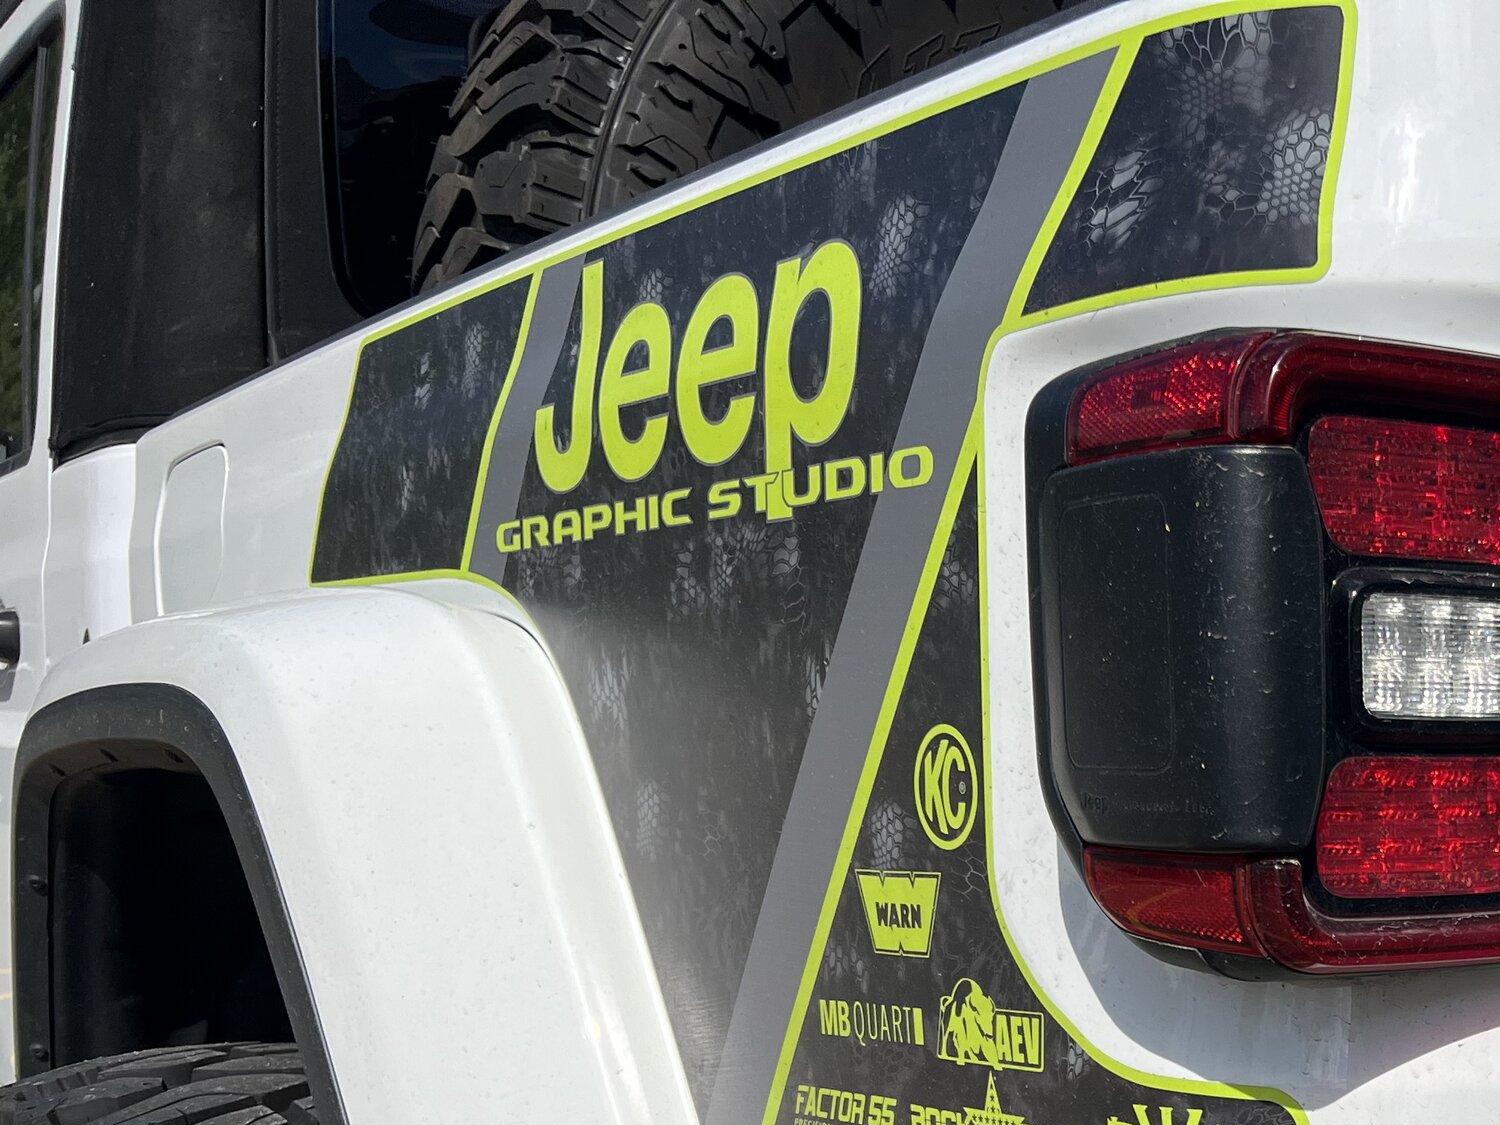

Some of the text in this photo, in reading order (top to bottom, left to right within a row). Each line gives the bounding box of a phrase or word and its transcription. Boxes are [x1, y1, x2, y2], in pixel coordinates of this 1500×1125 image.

[534, 239, 861, 521] Jeep
[496, 445, 934, 553] GRAPHIC STUDIO
[876, 900, 922, 930] WARN
[996, 1016, 1041, 1067] AEV
[795, 1084, 864, 1125] FACTOR
